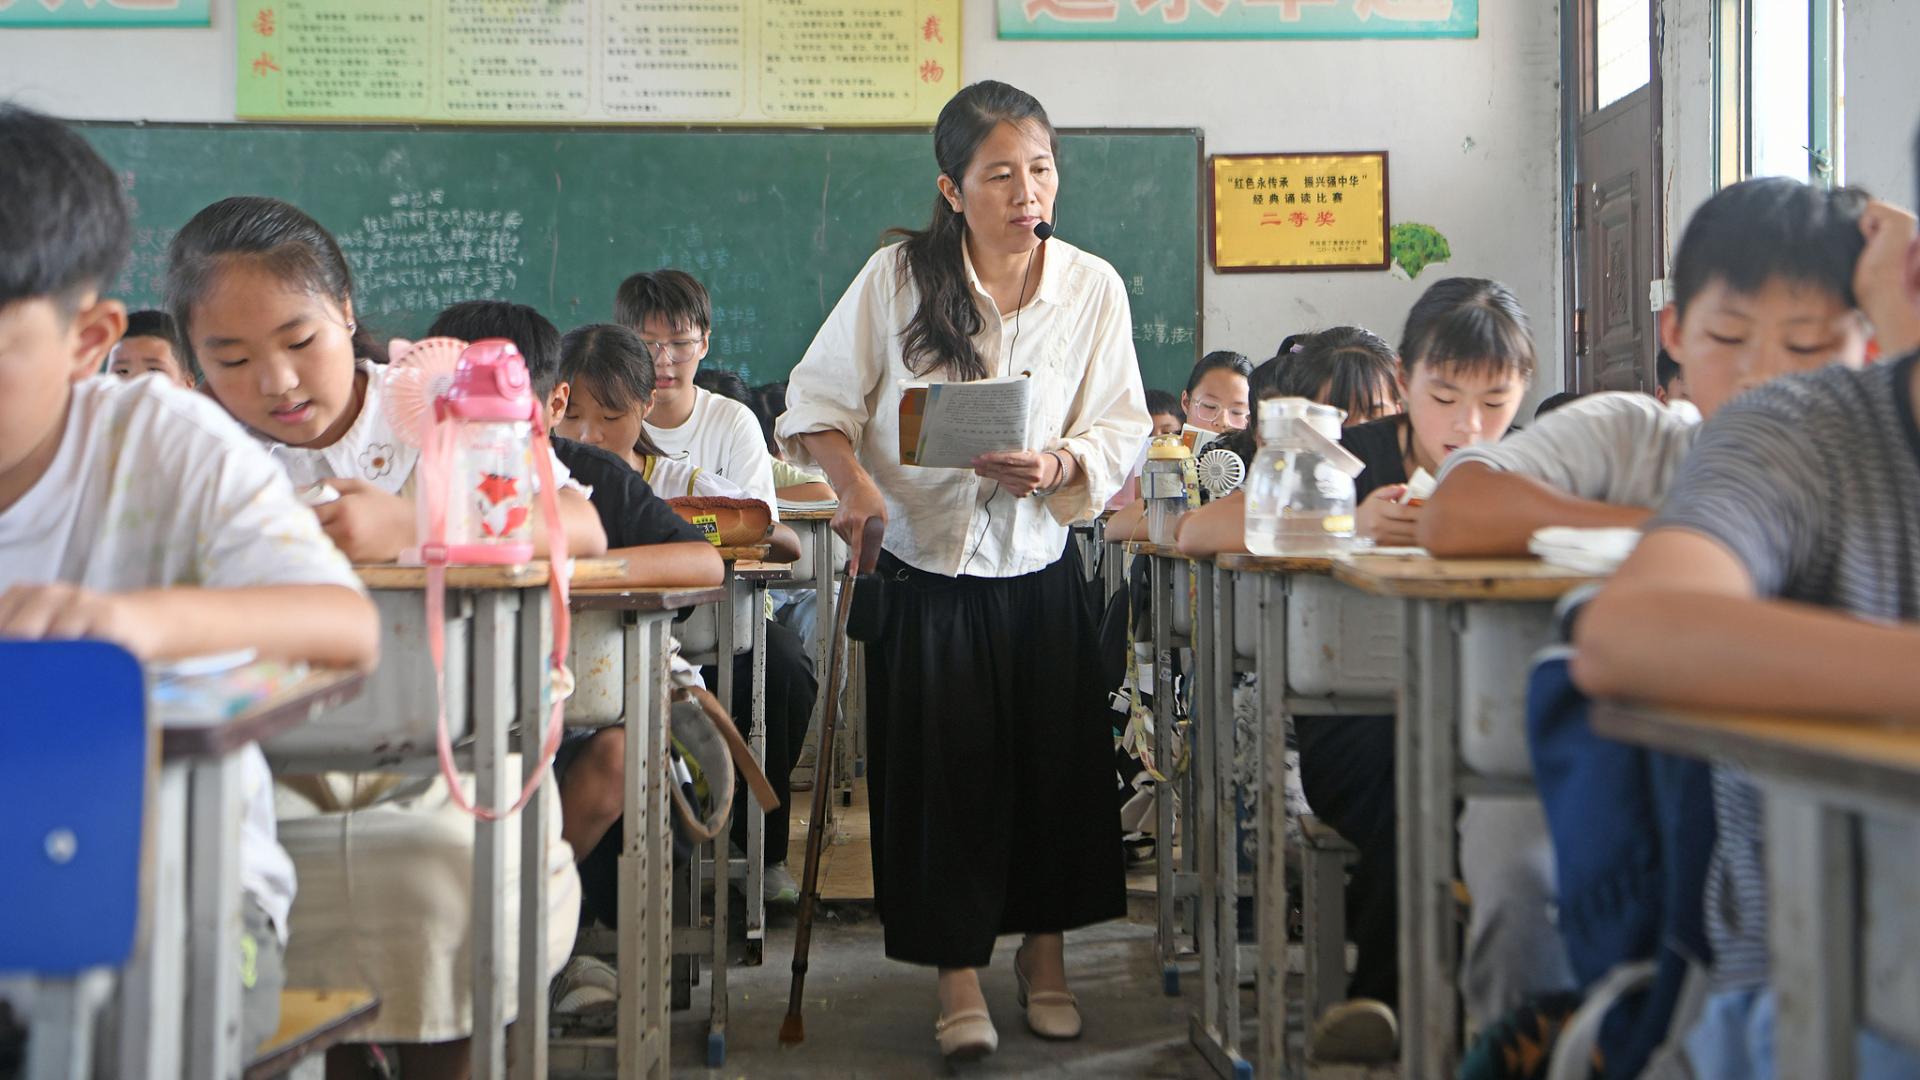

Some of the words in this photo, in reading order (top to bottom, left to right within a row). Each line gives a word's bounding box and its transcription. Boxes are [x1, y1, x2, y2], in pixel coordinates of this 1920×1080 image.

[1228, 176, 1289, 190] “红色永传承
[1303, 174, 1367, 188] 振兴强中华”
[1253, 192, 1343, 205] 经典诵读比赛
[1260, 211, 1336, 228] 二等奖
